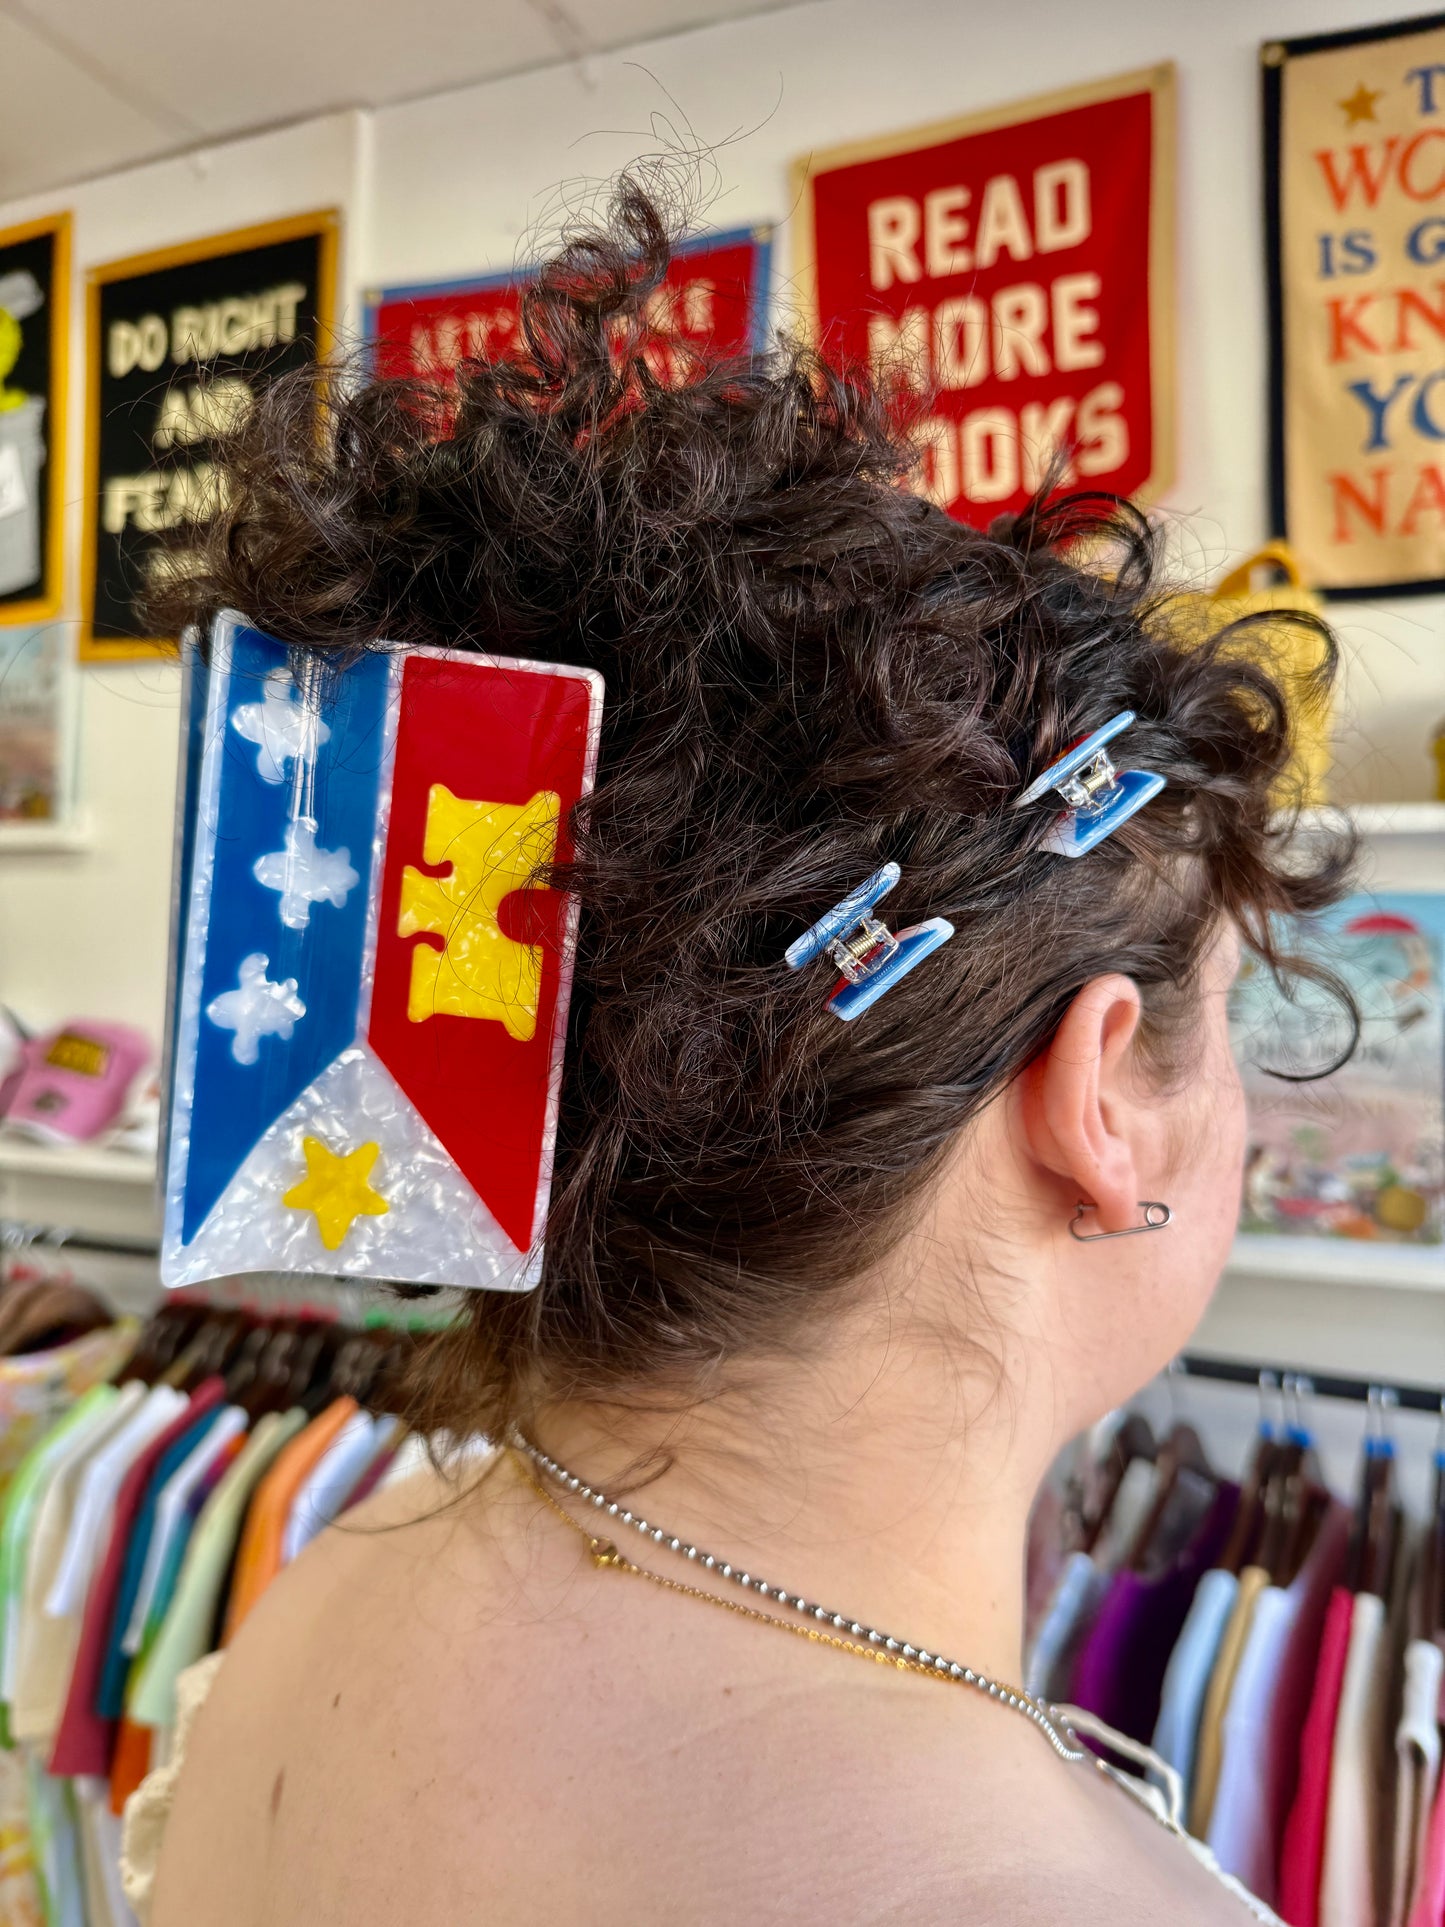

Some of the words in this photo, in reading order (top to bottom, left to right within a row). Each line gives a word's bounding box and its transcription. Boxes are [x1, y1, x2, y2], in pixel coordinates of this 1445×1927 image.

[867, 157, 1092, 290] READ
[1318, 229, 1378, 280] IS
[107, 314, 168, 379] DO
[171, 284, 307, 366] RIGHT
[867, 271, 1105, 398] MORE
[154, 376, 254, 449] AND
[880, 381, 1130, 509] OOKS
